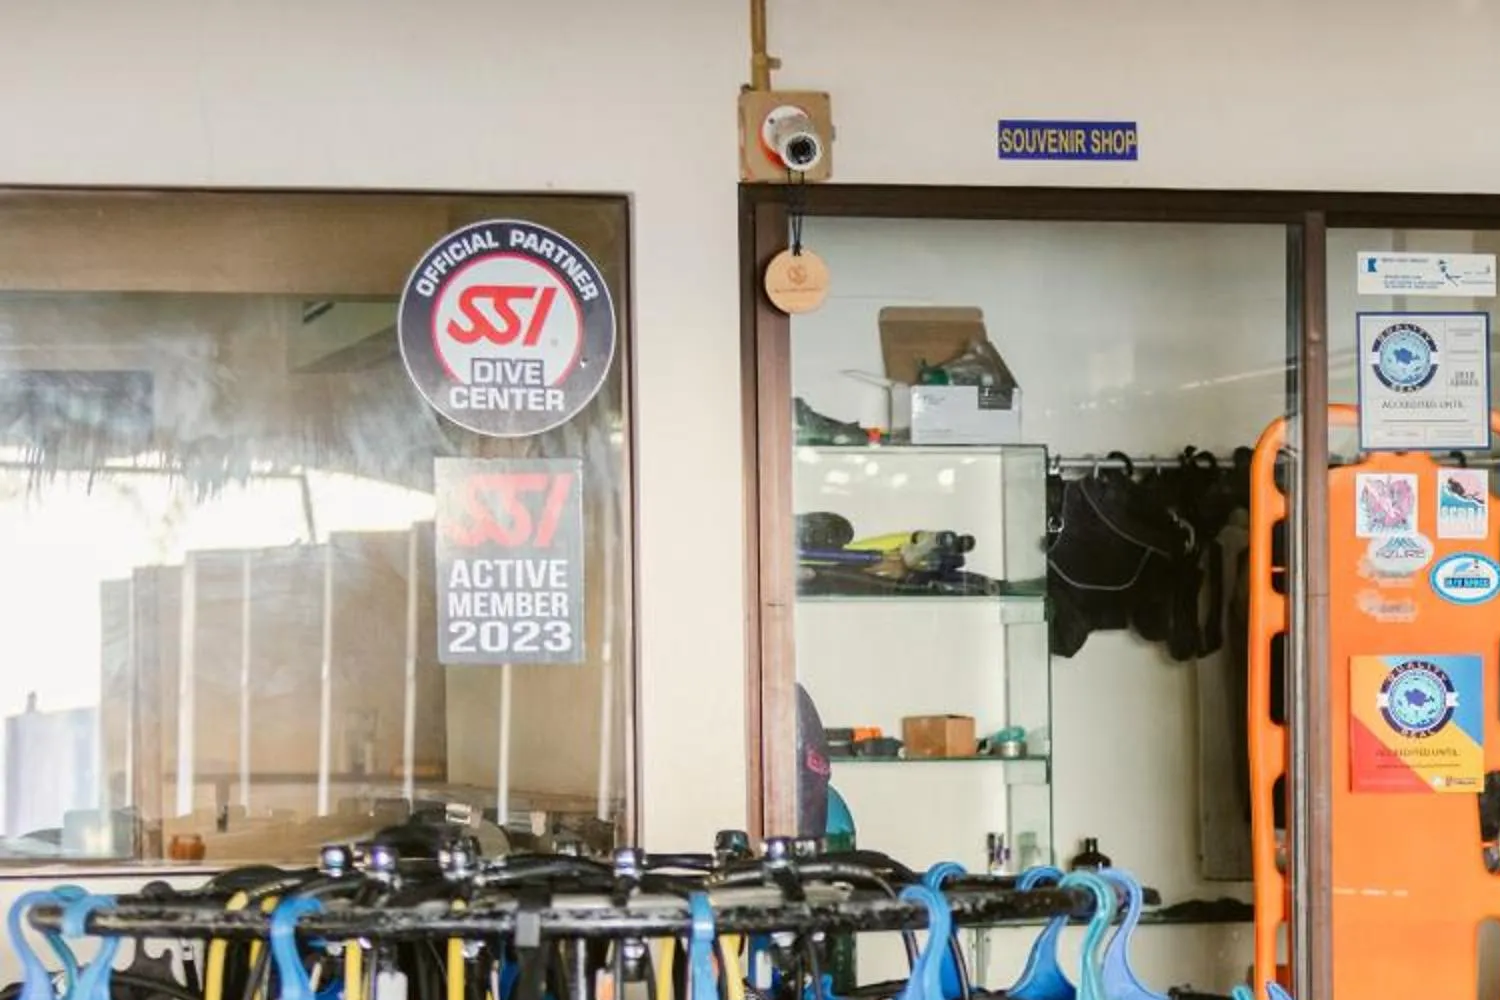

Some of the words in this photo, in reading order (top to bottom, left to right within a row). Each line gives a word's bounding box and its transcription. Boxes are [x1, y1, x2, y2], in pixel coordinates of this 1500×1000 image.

[1001, 128, 1086, 153] SOUVENIR
[1091, 129, 1137, 154] SHOP
[415, 230, 499, 298] OFFICIAL
[508, 229, 599, 302] PARTNER
[446, 285, 558, 346] SSI
[472, 361, 542, 384] DIVE
[450, 387, 566, 411] CENTER
[449, 559, 569, 589] ACTIVE
[448, 592, 569, 618] MEMBER
[449, 621, 573, 653] 2023
